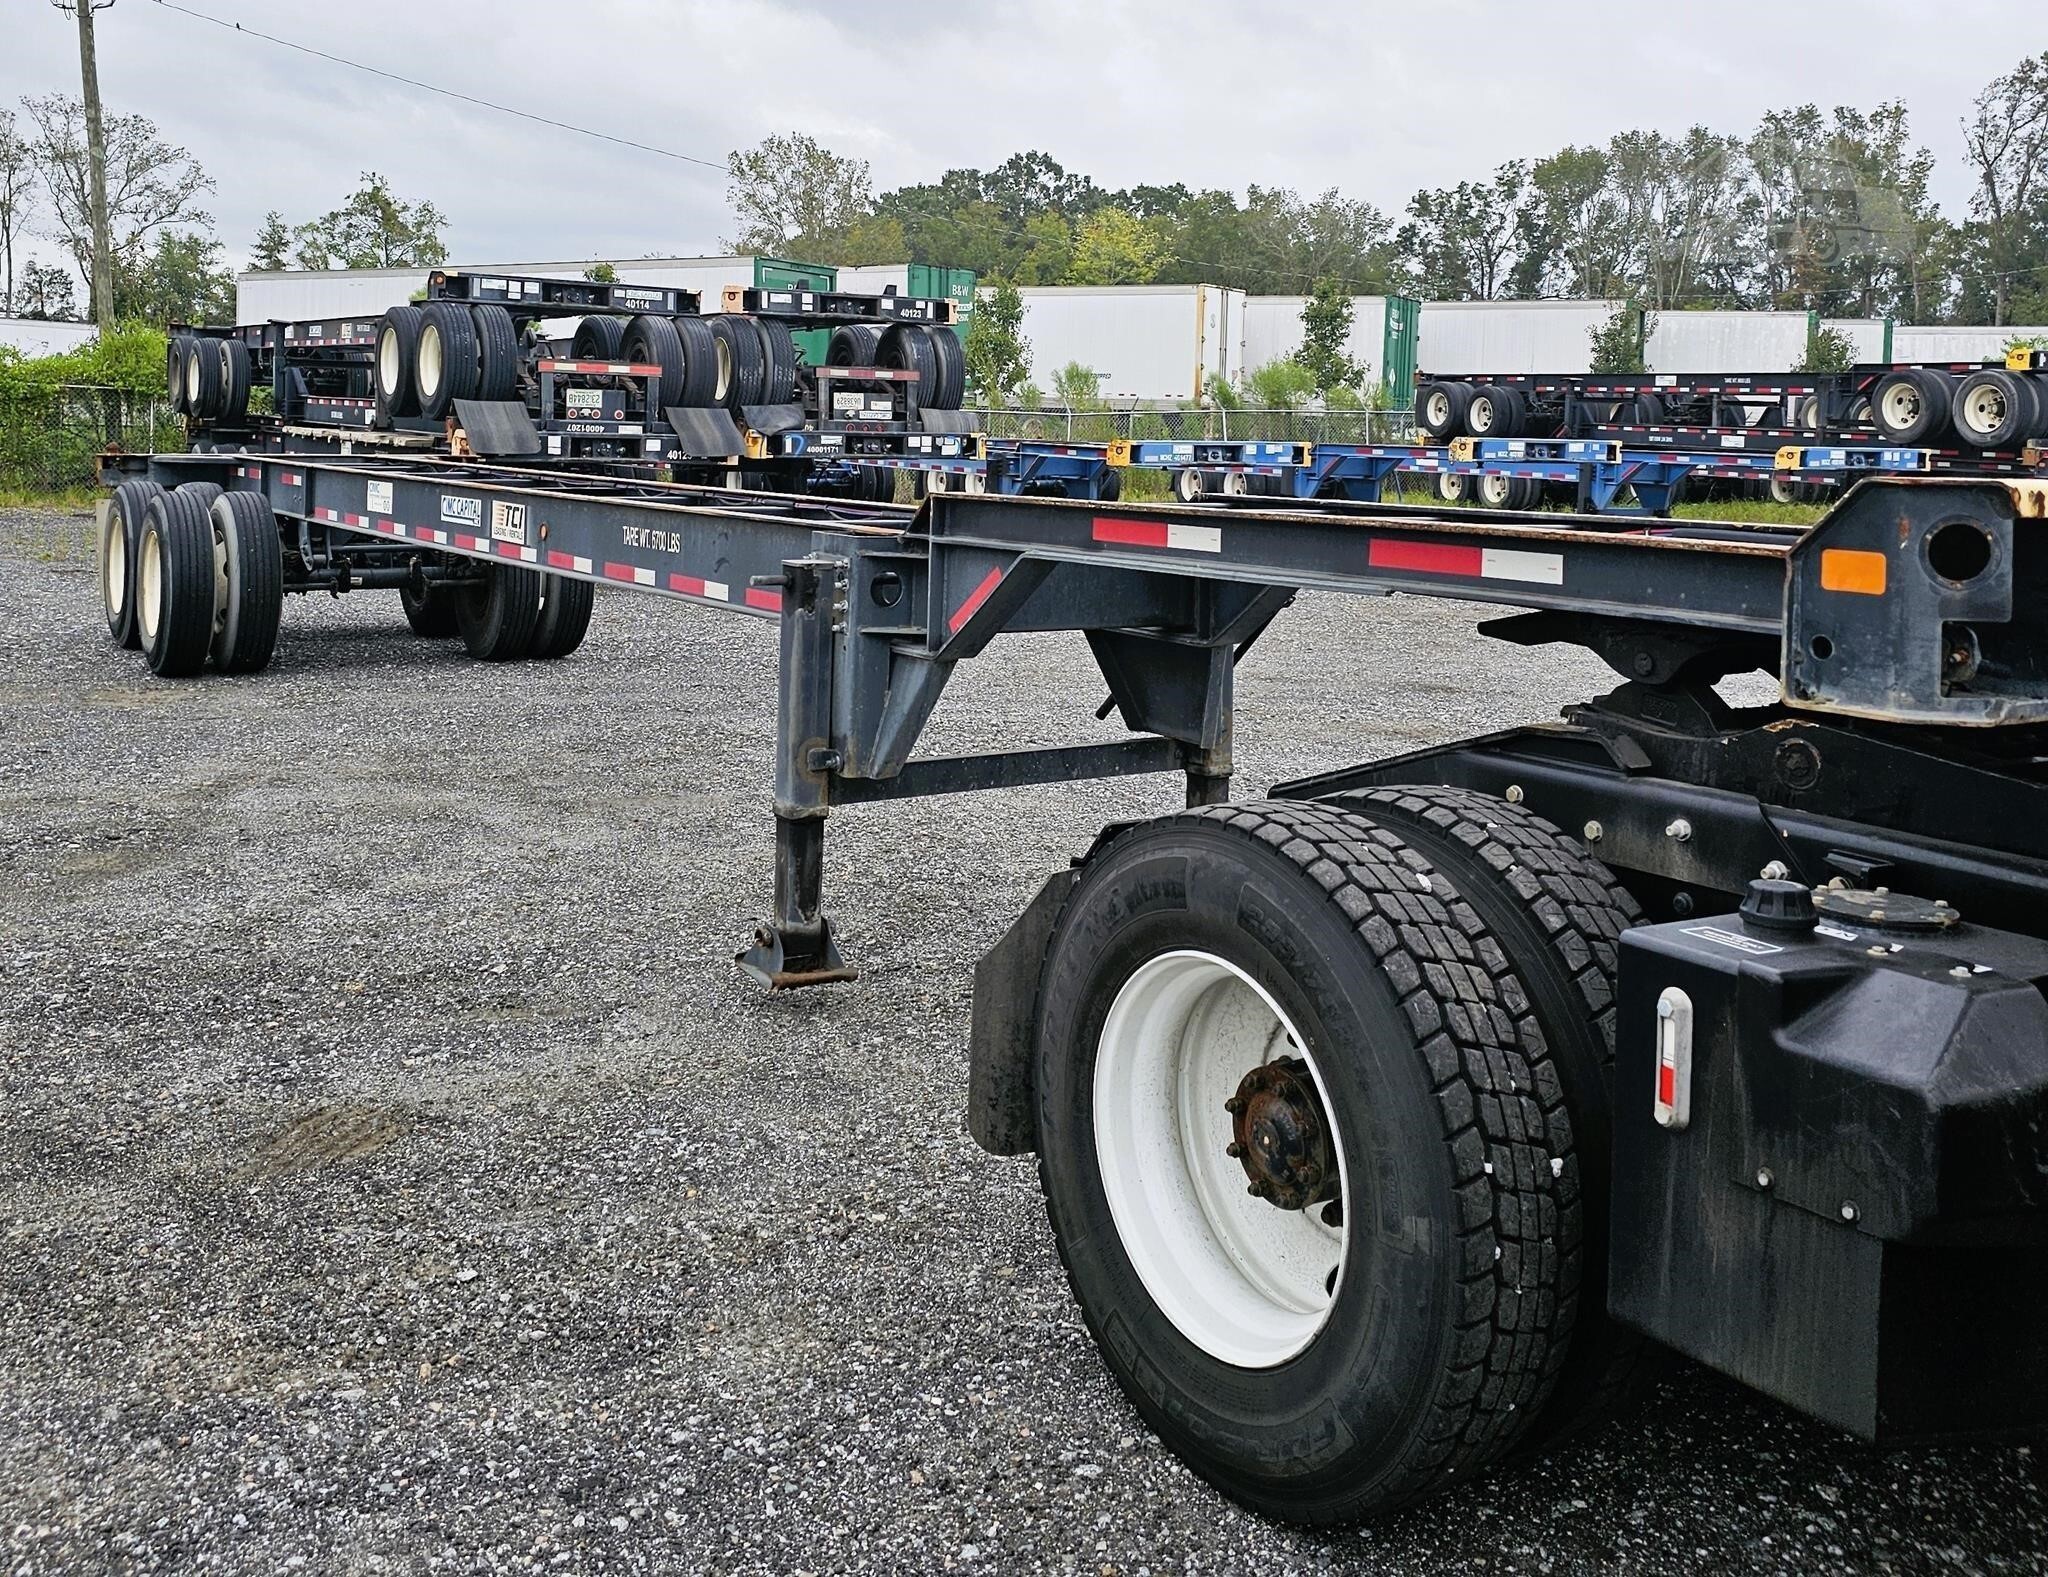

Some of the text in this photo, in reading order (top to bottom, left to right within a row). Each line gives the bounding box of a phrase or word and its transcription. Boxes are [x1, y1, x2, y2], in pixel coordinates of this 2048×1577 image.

[952, 284, 969, 296] B&W
[625, 299, 650, 310] 40114
[900, 308, 922, 318] 40123
[566, 424, 605, 433] 40001207
[456, 498, 480, 518] CAPITAL
[505, 504, 524, 529] TCI
[622, 525, 681, 553] TARE WT. 6700 LBS
